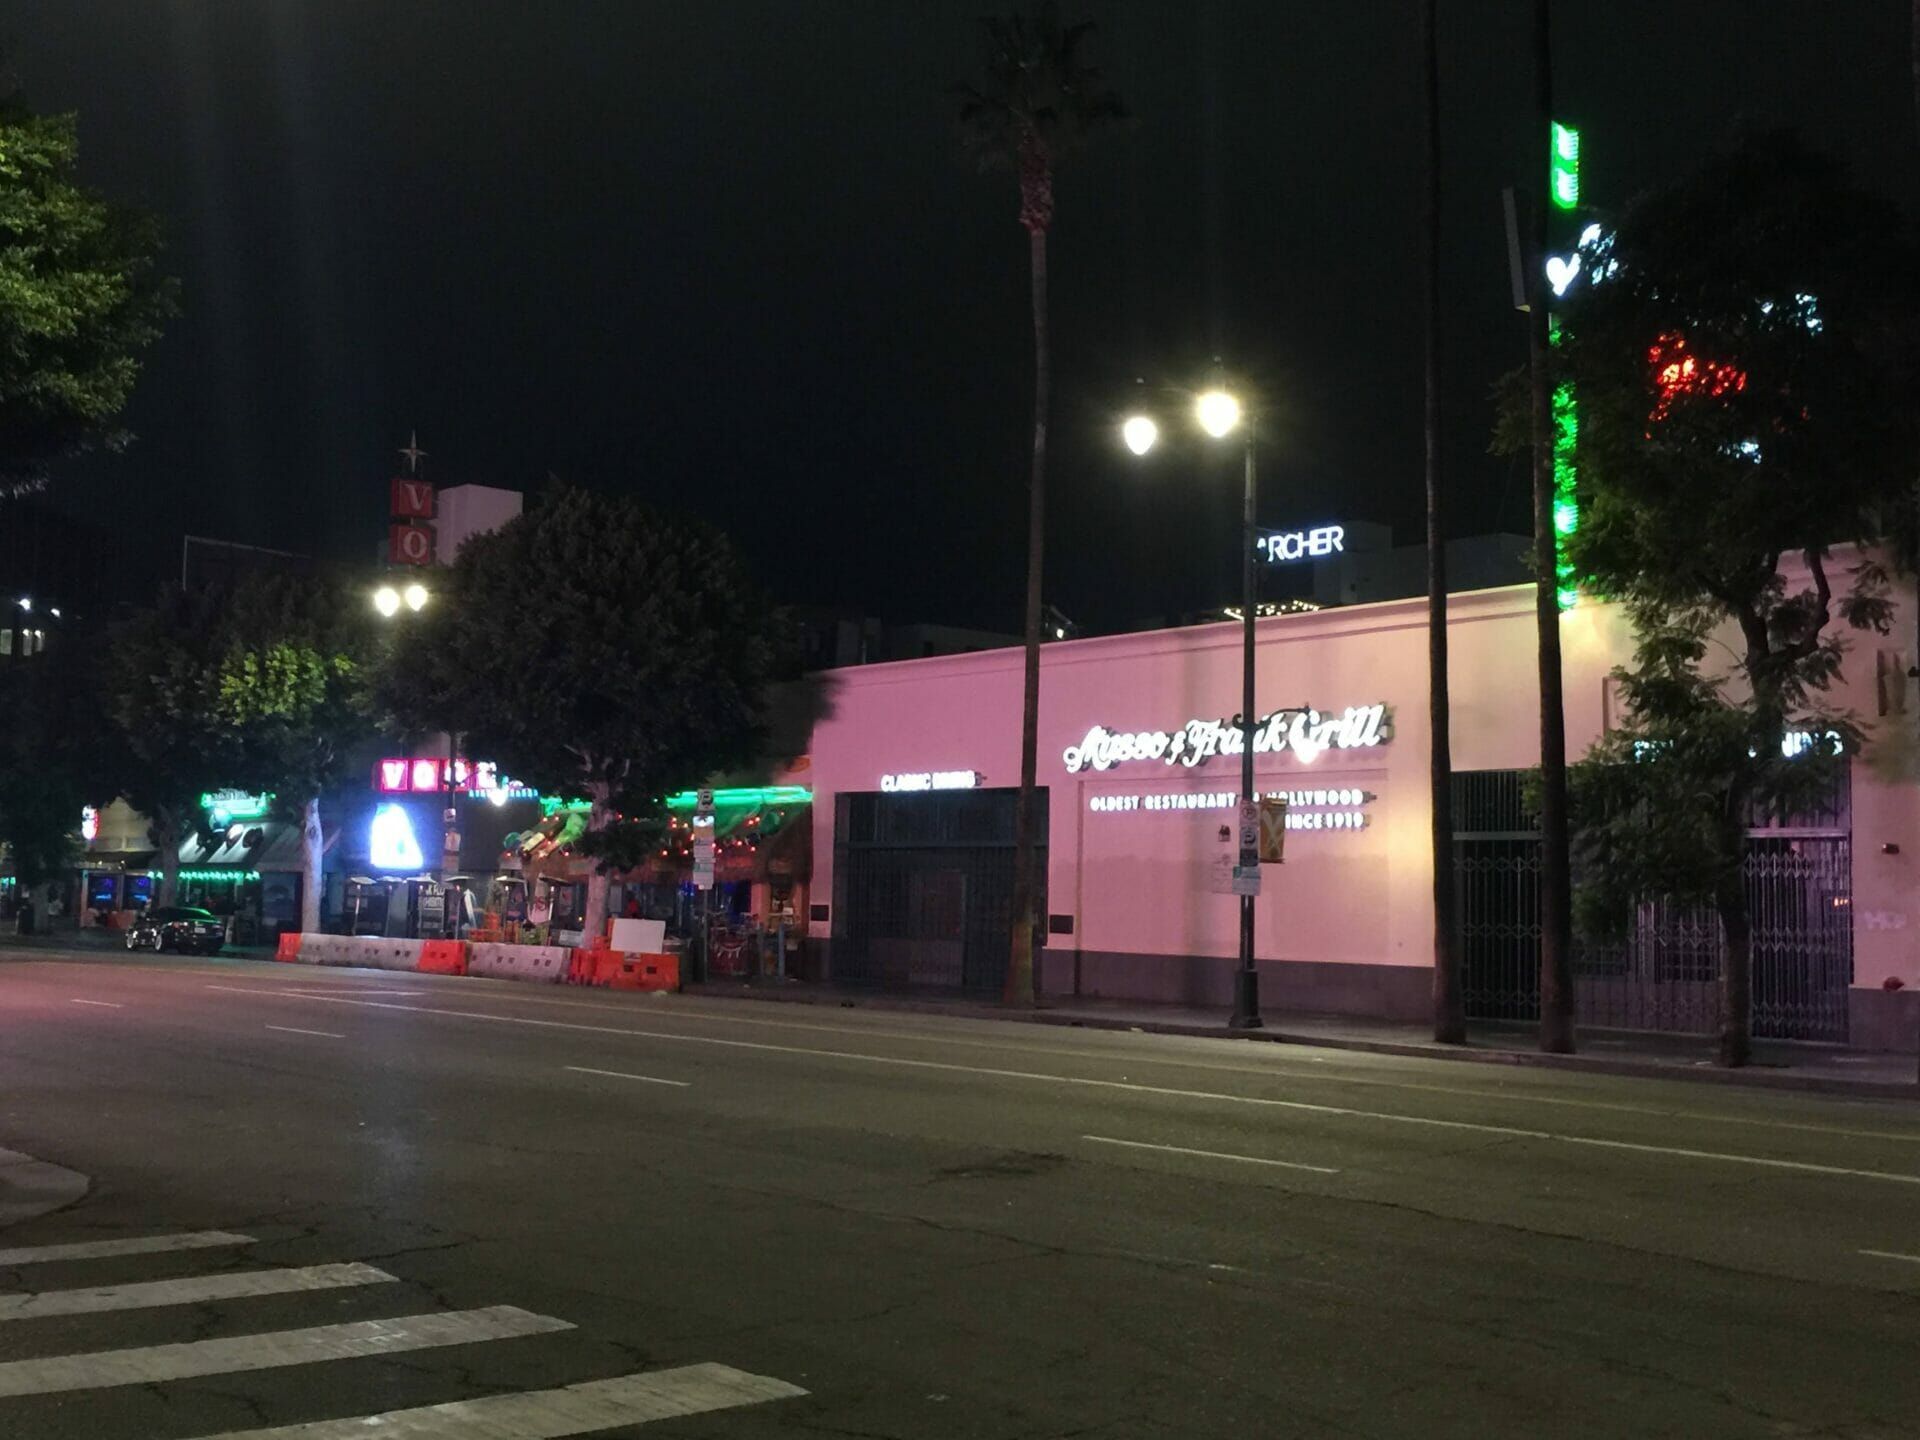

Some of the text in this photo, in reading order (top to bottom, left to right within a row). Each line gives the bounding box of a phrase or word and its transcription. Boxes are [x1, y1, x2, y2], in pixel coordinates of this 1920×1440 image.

[1090, 795, 1140, 811] OLDEST
[1144, 791, 1236, 810] RESTAURANT
[1285, 811, 1364, 829] INCE 1919
